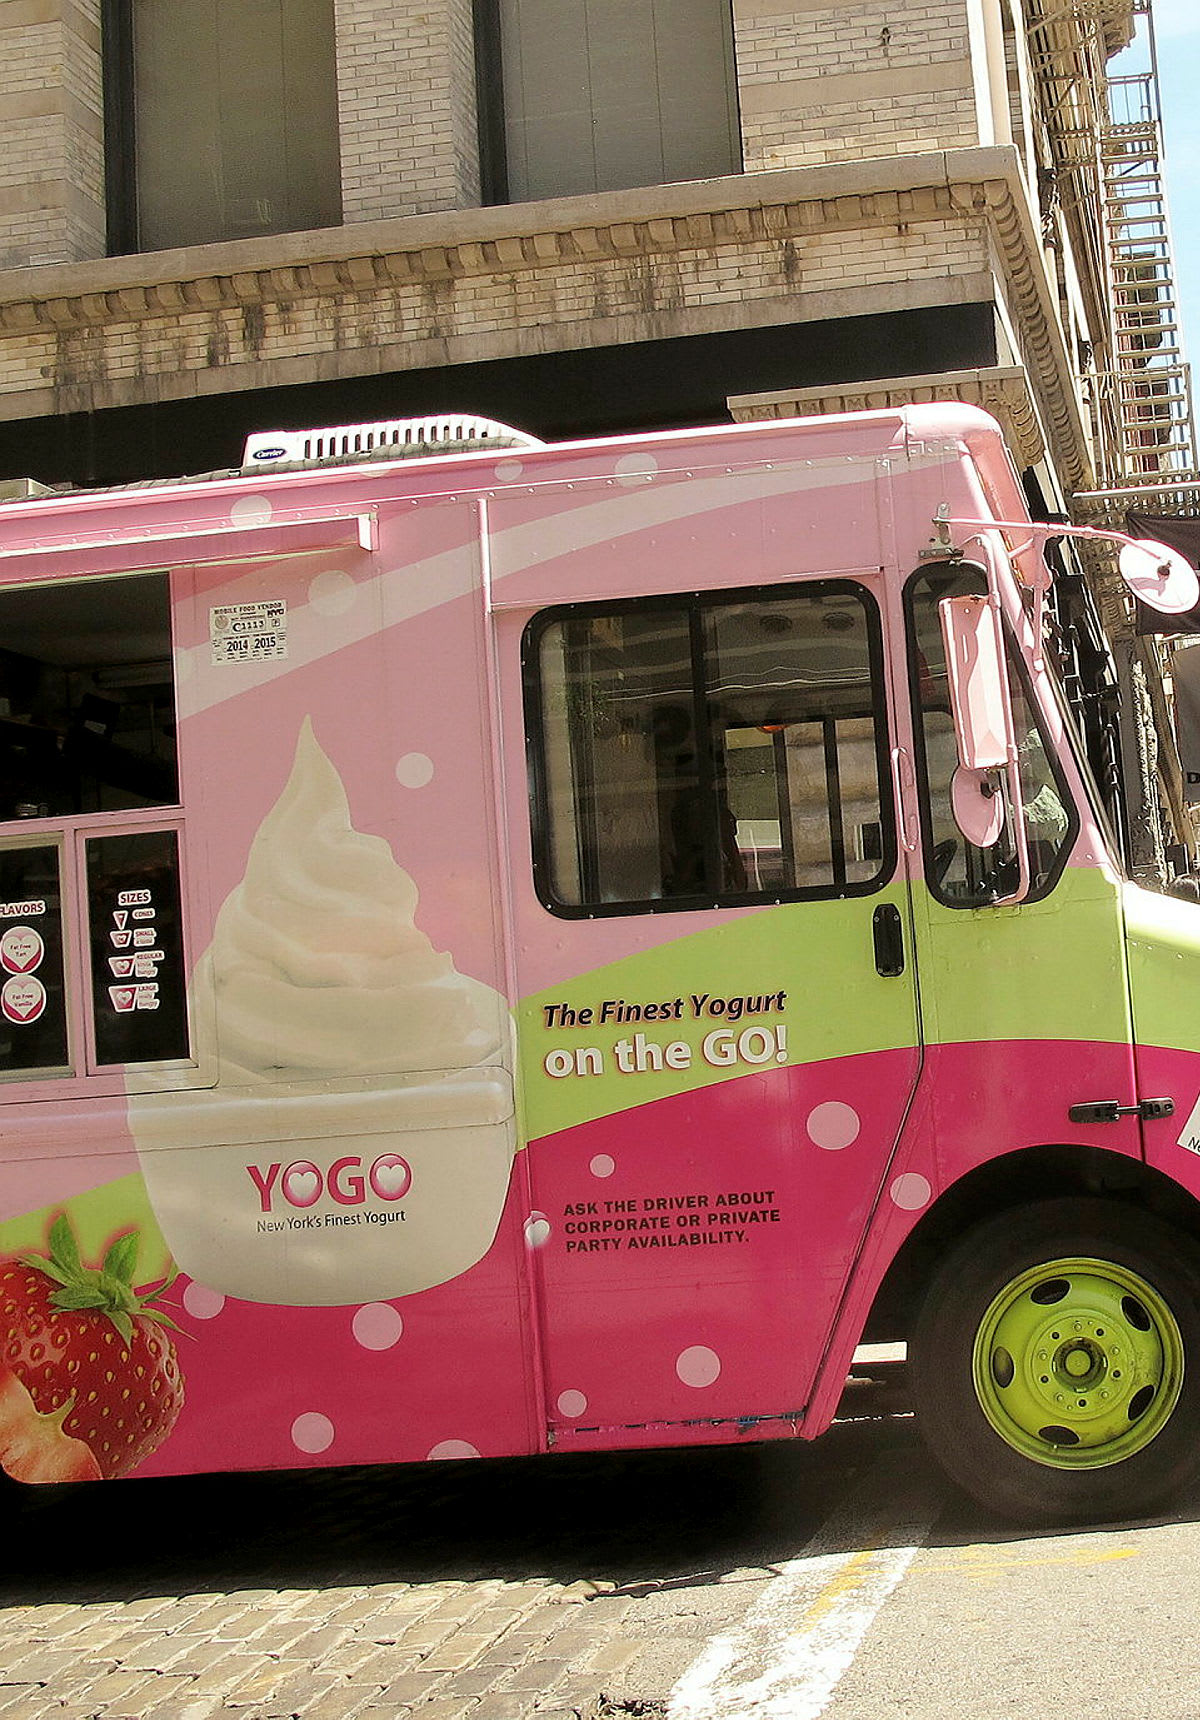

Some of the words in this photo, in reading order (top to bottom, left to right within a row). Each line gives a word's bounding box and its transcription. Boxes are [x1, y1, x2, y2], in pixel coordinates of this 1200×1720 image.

[226, 640, 248, 652] 2014
[254, 636, 276, 649] 2015
[120, 892, 149, 904] SIZES
[543, 1002, 594, 1028] The
[600, 997, 684, 1025] Finest
[691, 990, 788, 1021] Yogurt
[545, 1046, 604, 1078] on
[614, 1033, 692, 1073] the
[702, 1024, 788, 1067] GO!
[246, 1153, 412, 1212] YOGO
[563, 1202, 598, 1216] ASK
[603, 1200, 637, 1214] THE
[644, 1195, 709, 1211] DRIVER
[715, 1191, 775, 1206] ABOUT
[257, 1220, 285, 1232] New
[287, 1215, 321, 1229] York's
[325, 1213, 361, 1227] Finest
[364, 1211, 406, 1226] Yogurt
[565, 1216, 670, 1234] CORPORATE
[676, 1214, 700, 1228] OR
[707, 1209, 780, 1226] PRIVATE
[566, 1237, 622, 1253] PARTY
[627, 1230, 749, 1250] AVAILABILITY.
